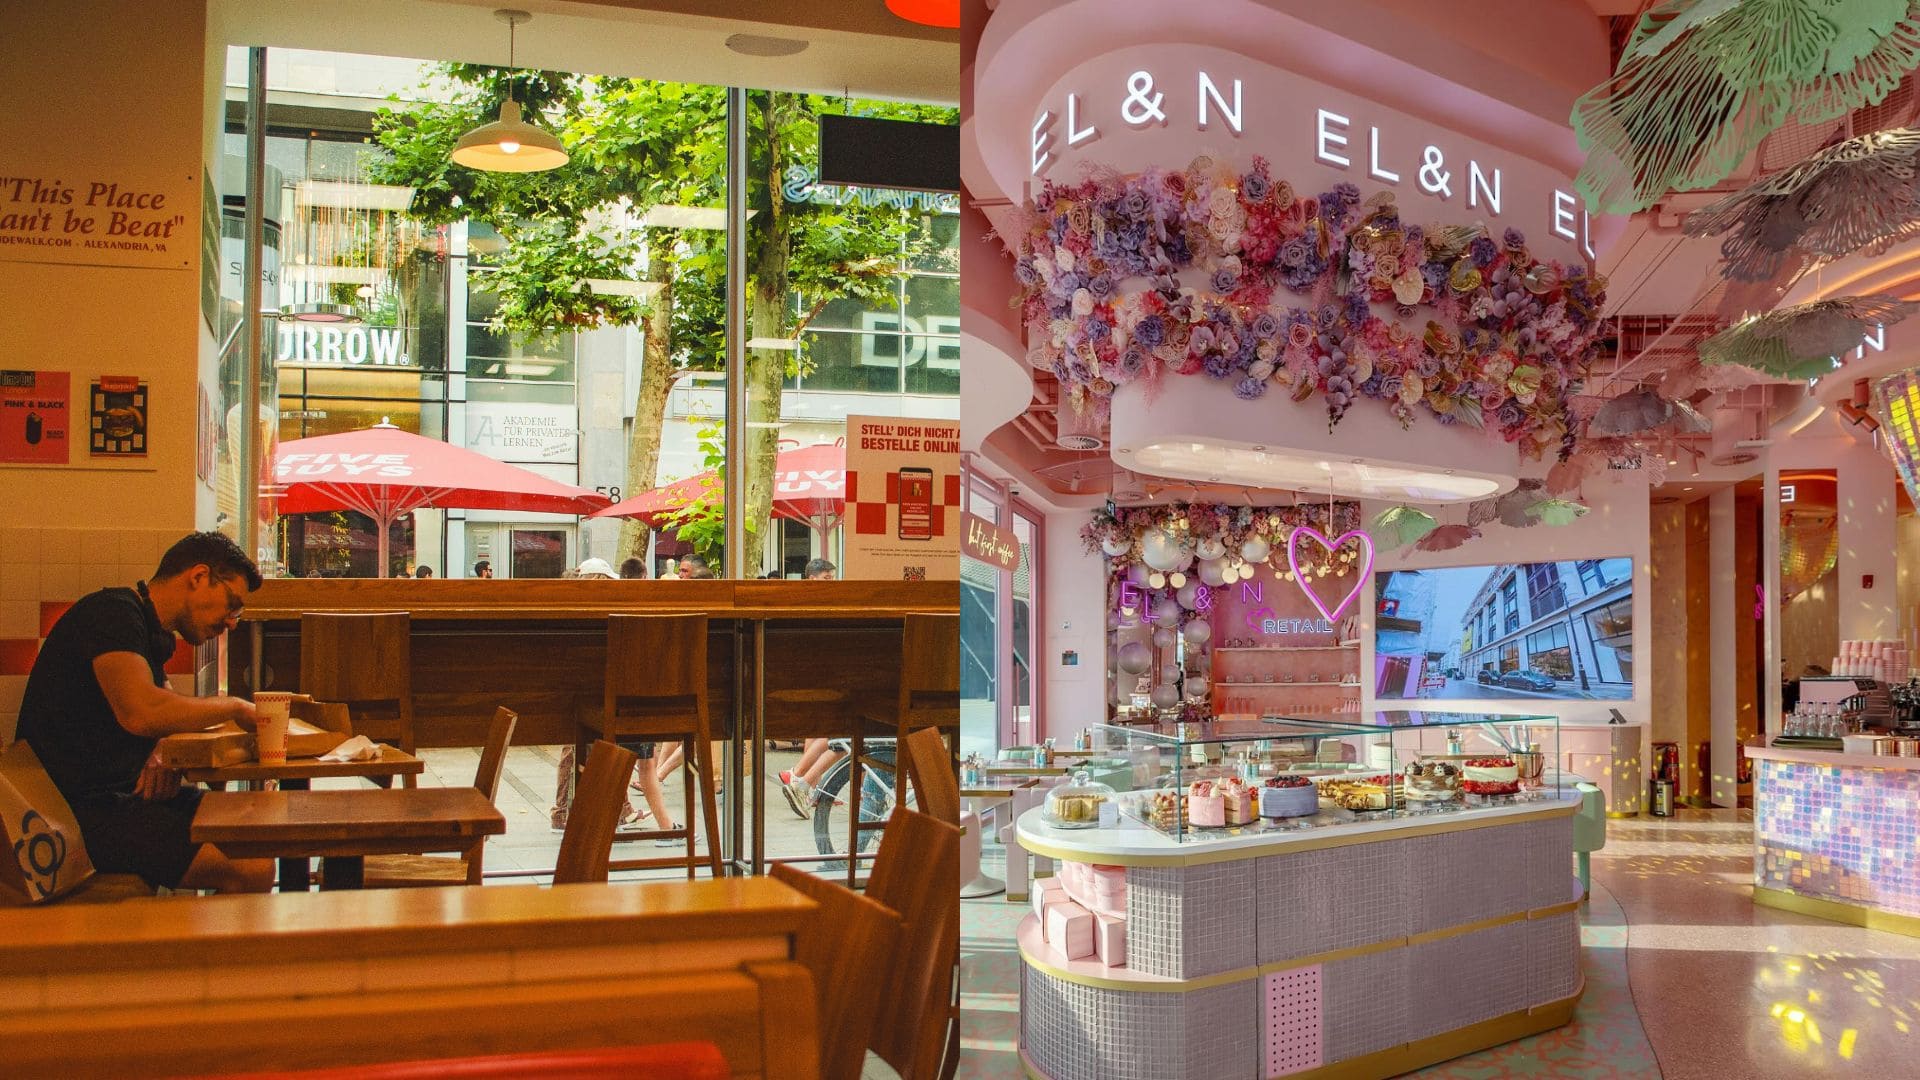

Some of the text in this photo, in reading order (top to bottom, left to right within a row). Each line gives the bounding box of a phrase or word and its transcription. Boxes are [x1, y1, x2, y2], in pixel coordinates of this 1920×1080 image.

[1318, 108, 1501, 214] EL&N
[86, 182, 165, 210] Place
[0, 207, 184, 239] an't be Beat"
[503, 416, 557, 427] AKADEMIE
[897, 427, 921, 437] DICH
[924, 428, 955, 439] NICHT
[503, 437, 544, 448] LERNEN
[861, 438, 920, 452] BESTELLE
[923, 441, 960, 454] ONLIN
[279, 453, 409, 465] FIVE
[1263, 617, 1334, 635] RETAIL
